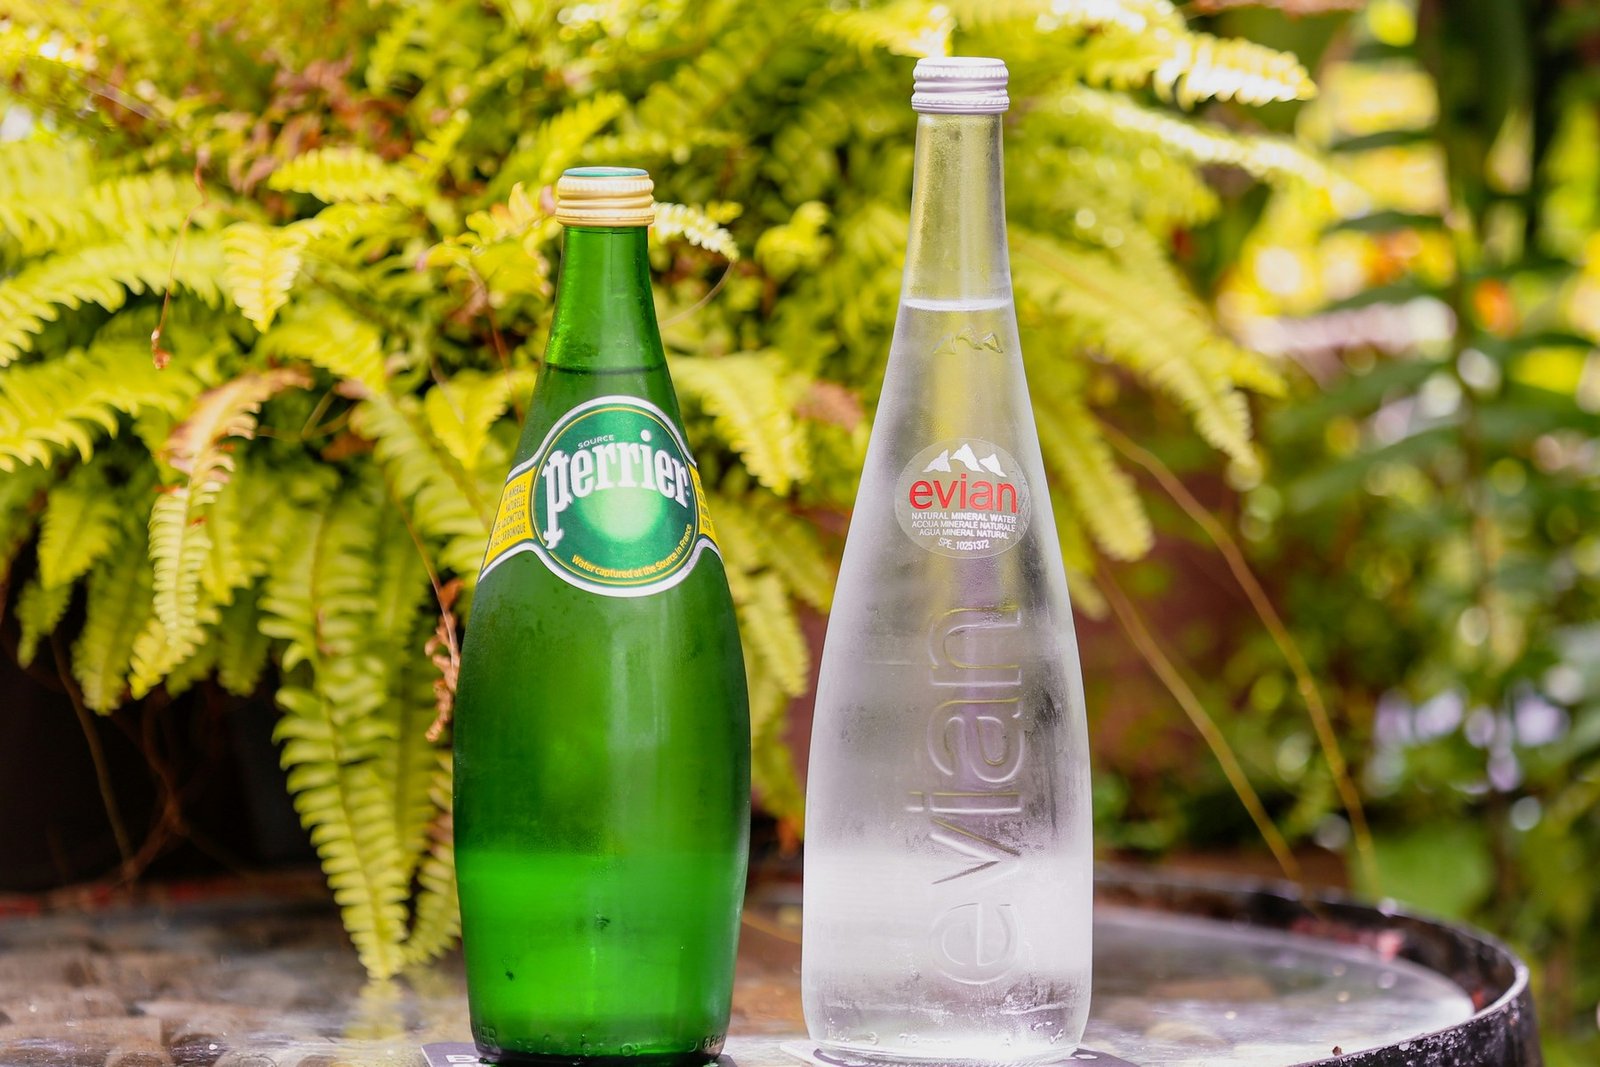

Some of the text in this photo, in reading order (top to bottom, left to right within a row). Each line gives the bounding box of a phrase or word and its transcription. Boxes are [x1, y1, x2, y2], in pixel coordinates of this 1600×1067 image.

[577, 434, 615, 449] SOURCE
[908, 473, 1018, 514] evian
[911, 512, 1017, 524] NATURAL MINERAL WATER
[911, 520, 1016, 533] ACQUA MINERALE NATURALE
[919, 528, 1009, 539] AGUA MINERAL NATURAL
[571, 523, 692, 578] Water captured at the Source in France
[905, 605, 1025, 986] evian
